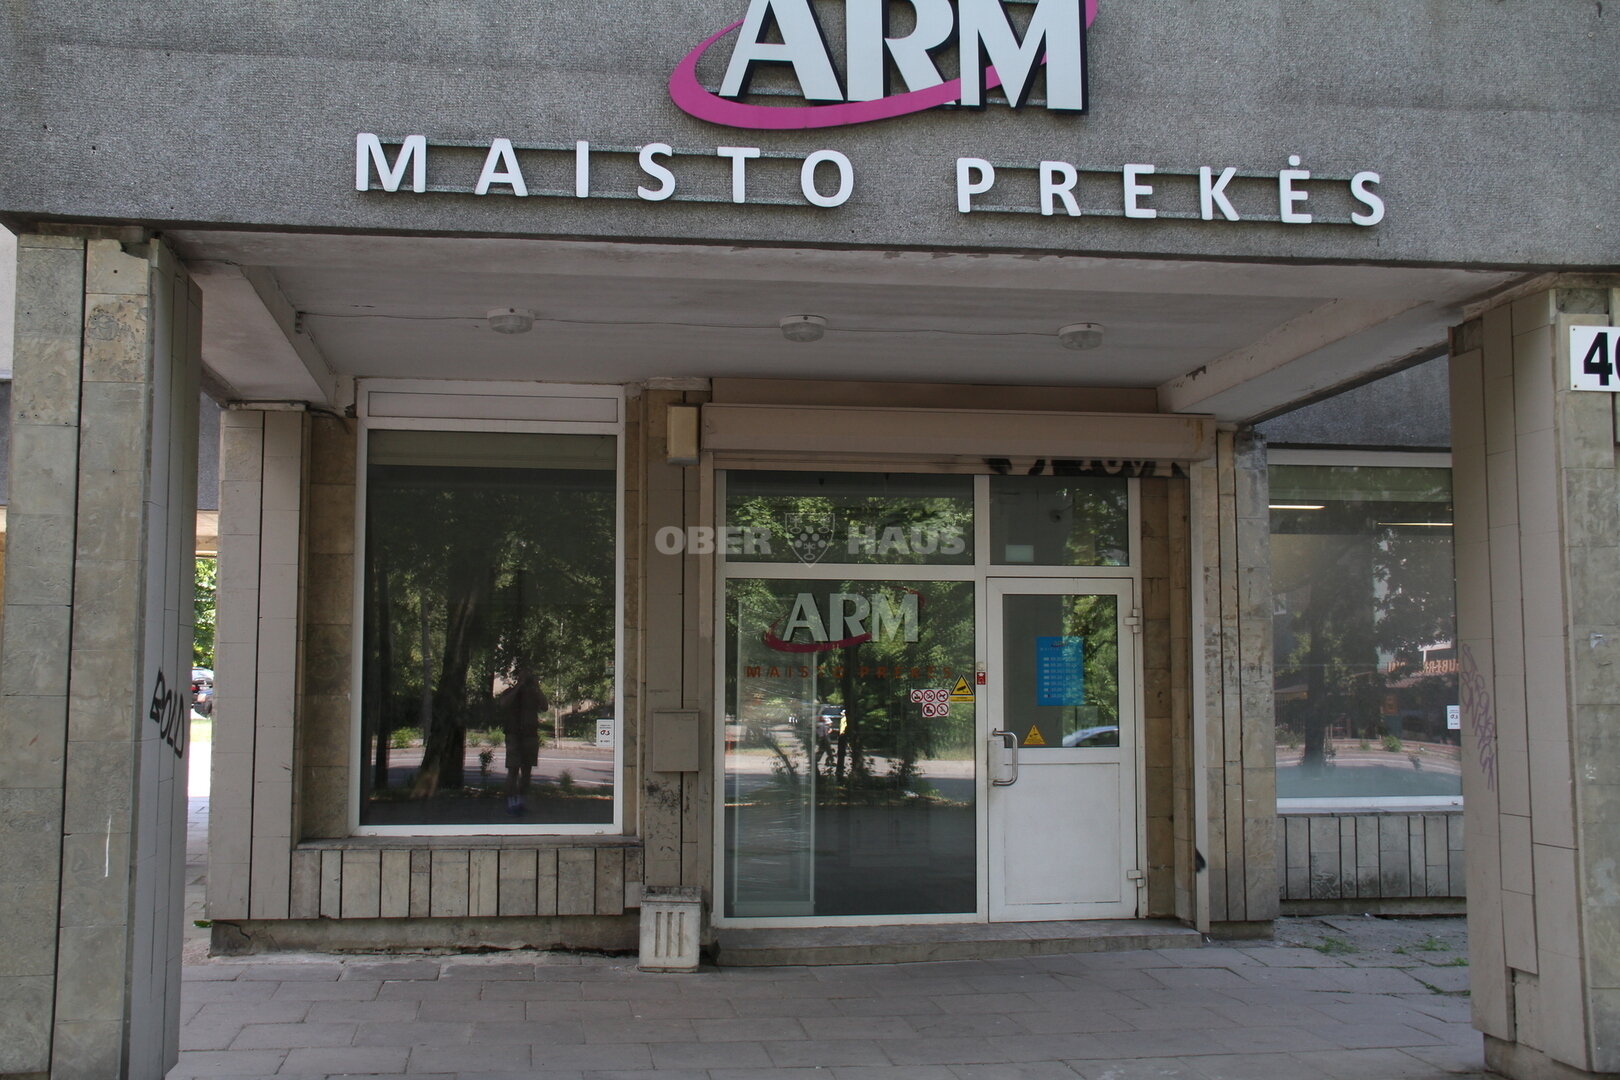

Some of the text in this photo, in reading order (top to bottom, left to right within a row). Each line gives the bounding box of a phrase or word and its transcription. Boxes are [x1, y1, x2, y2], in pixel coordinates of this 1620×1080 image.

[718, 0, 1086, 111] ARM
[356, 133, 1385, 227] MAISTO PREKĖS
[1584, 332, 1620, 386] 4
[782, 592, 919, 642] ARM
[745, 665, 847, 679] MAISTO
